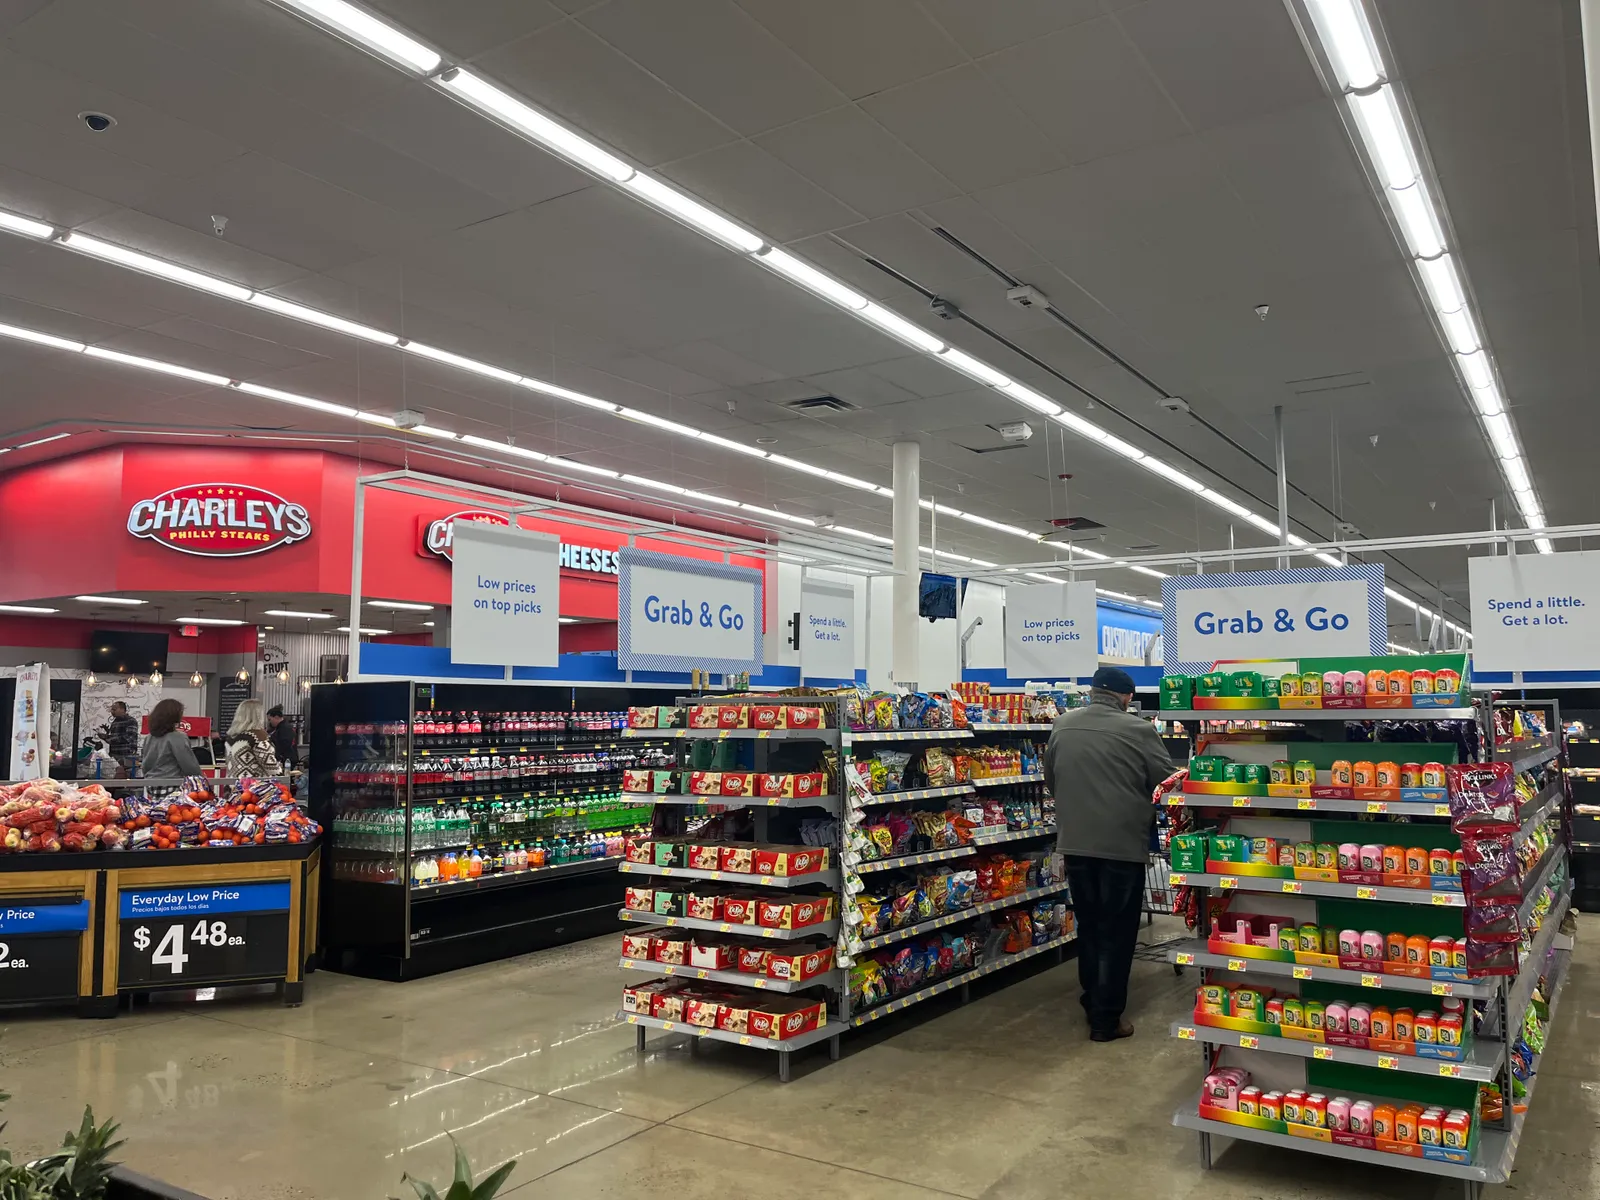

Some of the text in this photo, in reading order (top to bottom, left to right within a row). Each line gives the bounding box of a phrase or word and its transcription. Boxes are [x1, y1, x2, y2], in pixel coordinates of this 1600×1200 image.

[129, 498, 309, 535] CHARLEYS
[169, 530, 270, 541] PHILLY STEAKS
[477, 574, 536, 594] Low prices
[473, 598, 542, 615] on top picks
[1487, 596, 1585, 613] Spend a little.
[644, 595, 744, 631] Grab & Go
[1194, 606, 1349, 635] Grab & Go
[1502, 614, 1568, 626] Get a lot.
[809, 614, 828, 627] Spend
[832, 617, 847, 628] little.
[1024, 617, 1075, 630] Low prices
[815, 630, 825, 640] Get
[1036, 633, 1053, 643] top
[1055, 631, 1080, 643] picks
[132, 890, 240, 906] Everyday Low Price
[7, 909, 35, 920] Price
